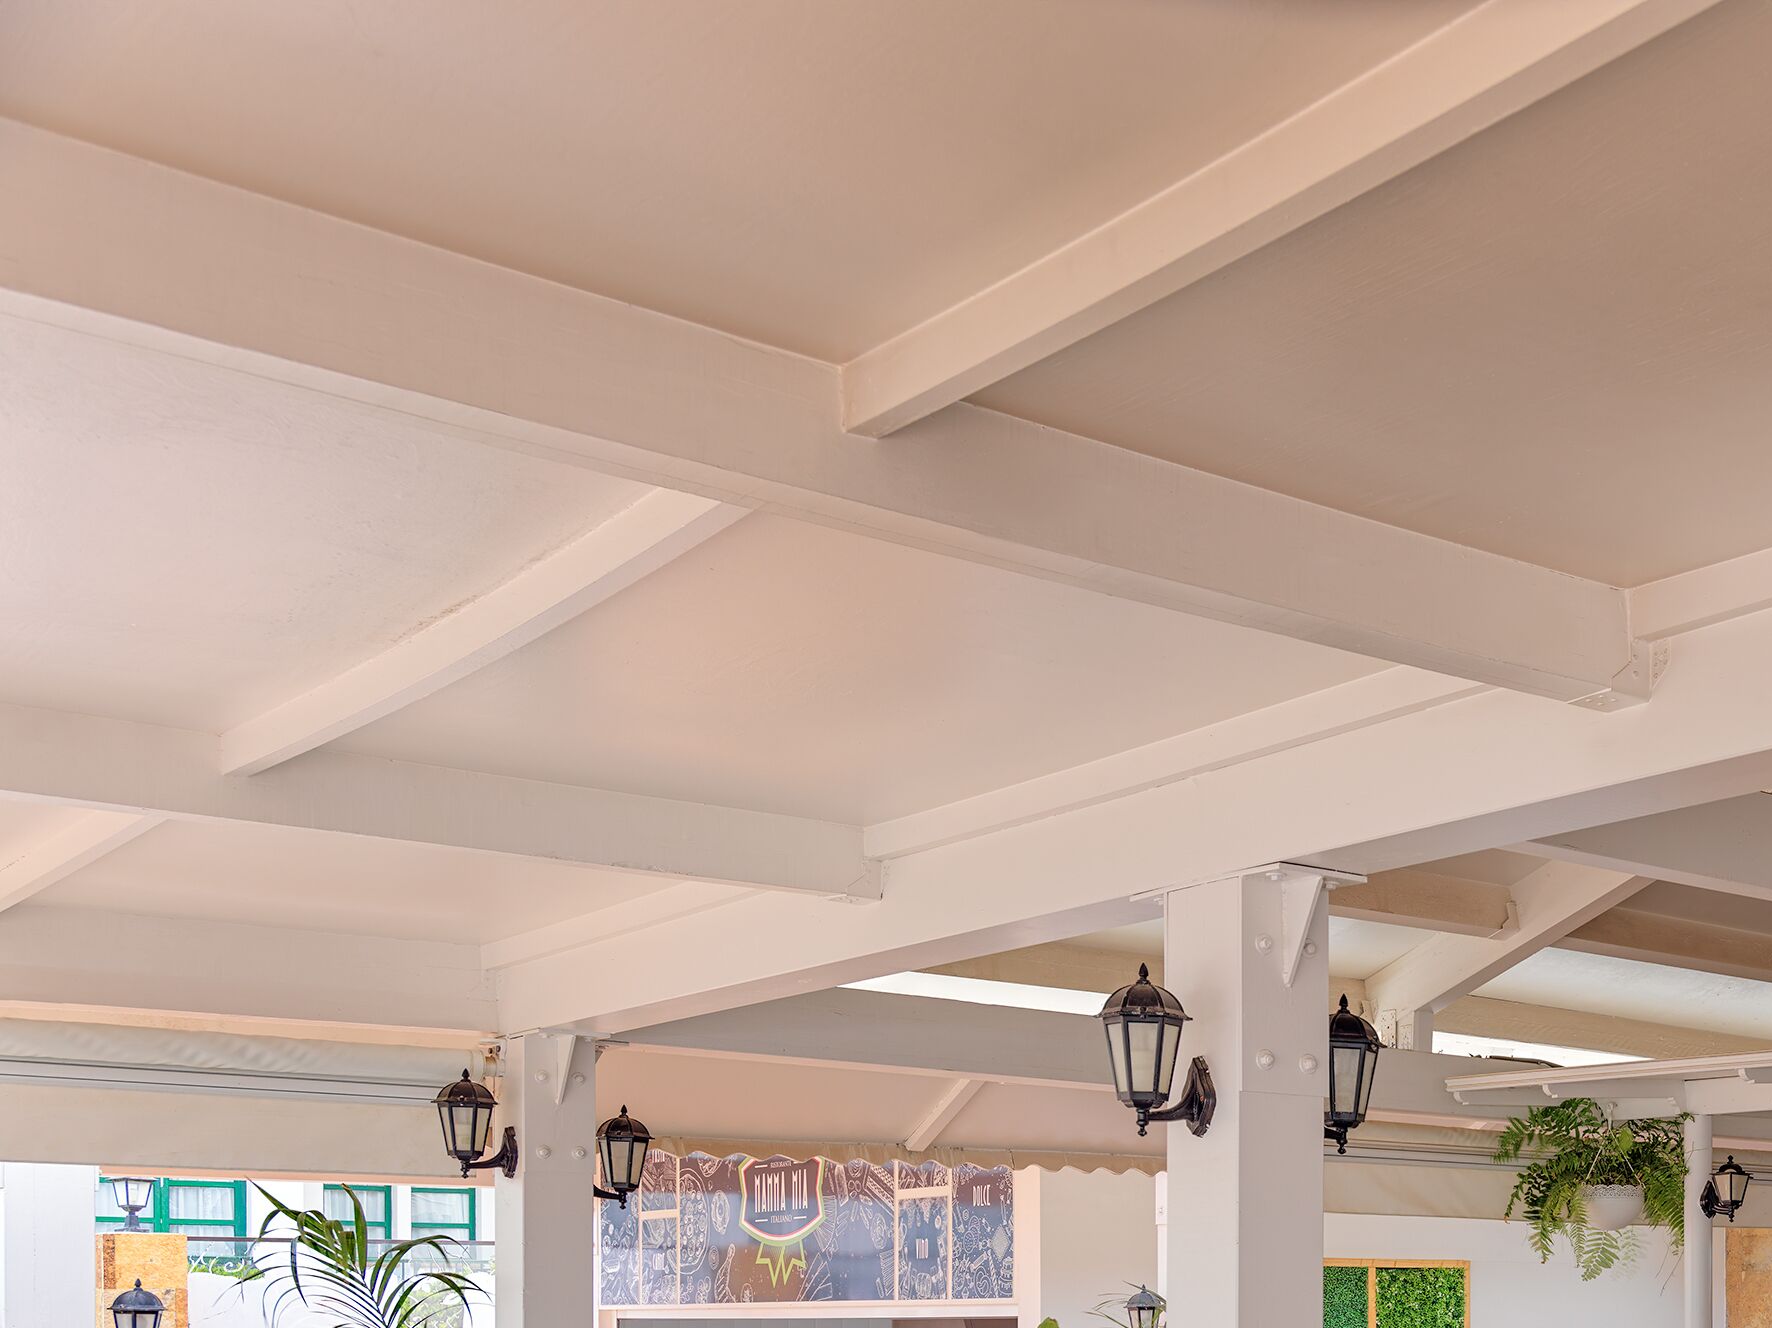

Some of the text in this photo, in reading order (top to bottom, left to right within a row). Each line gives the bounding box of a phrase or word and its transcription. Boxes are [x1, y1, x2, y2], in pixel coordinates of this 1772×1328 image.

[754, 1169, 808, 1213] MAMMA MIA
[972, 1184, 991, 1207] DOLCE
